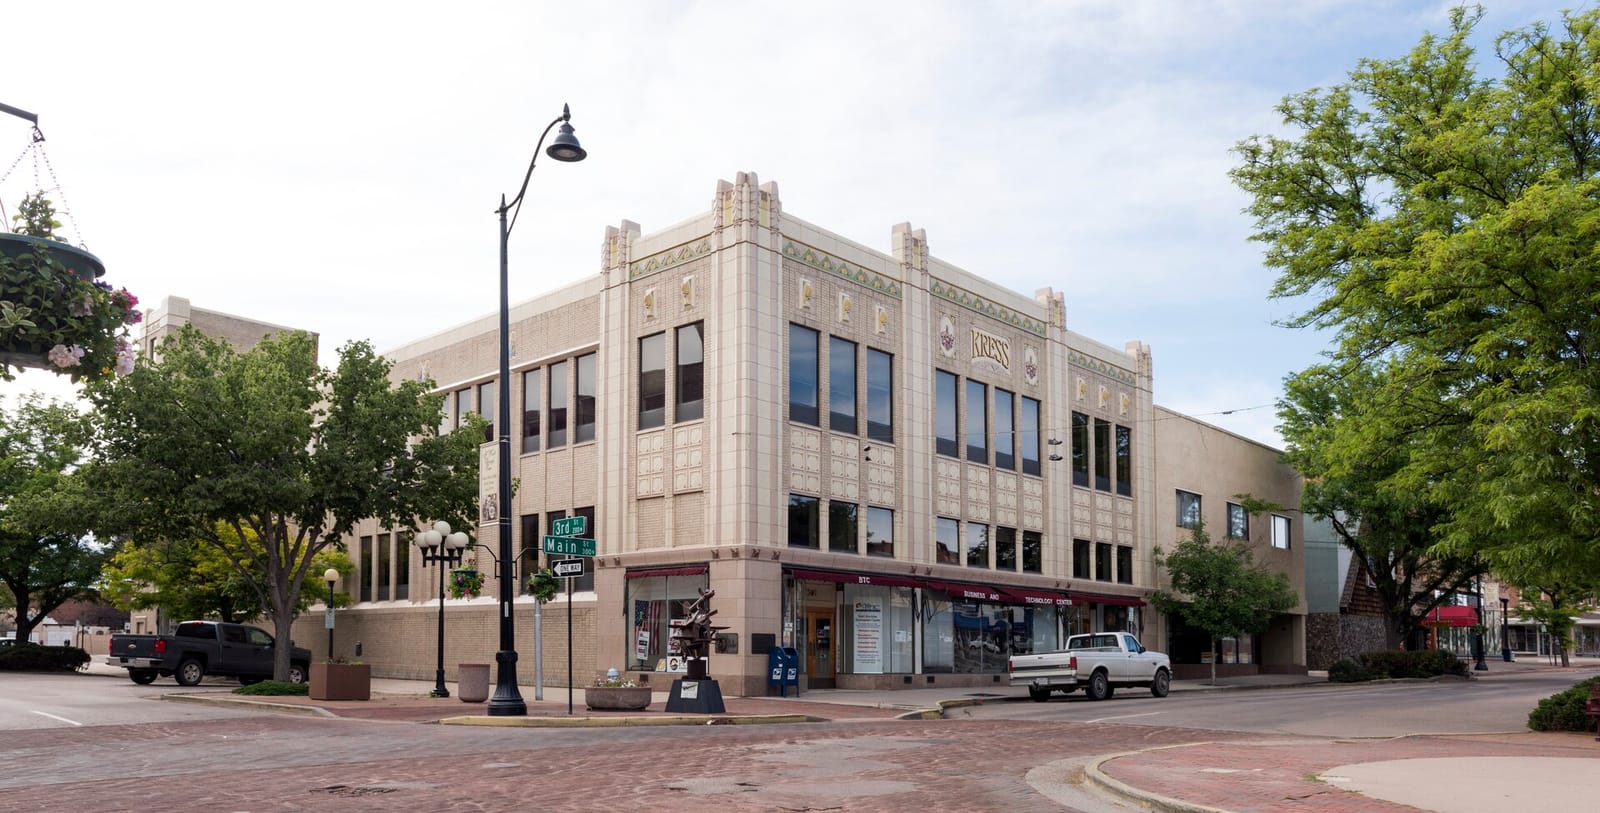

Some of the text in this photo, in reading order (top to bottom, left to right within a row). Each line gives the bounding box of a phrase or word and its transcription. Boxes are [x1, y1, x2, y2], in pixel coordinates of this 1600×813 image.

[971, 330, 1009, 369] KRESS
[555, 522, 570, 535] 3rd
[547, 538, 577, 553] Main
[858, 576, 871, 584] BTC
[964, 591, 985, 599] BUSINESS
